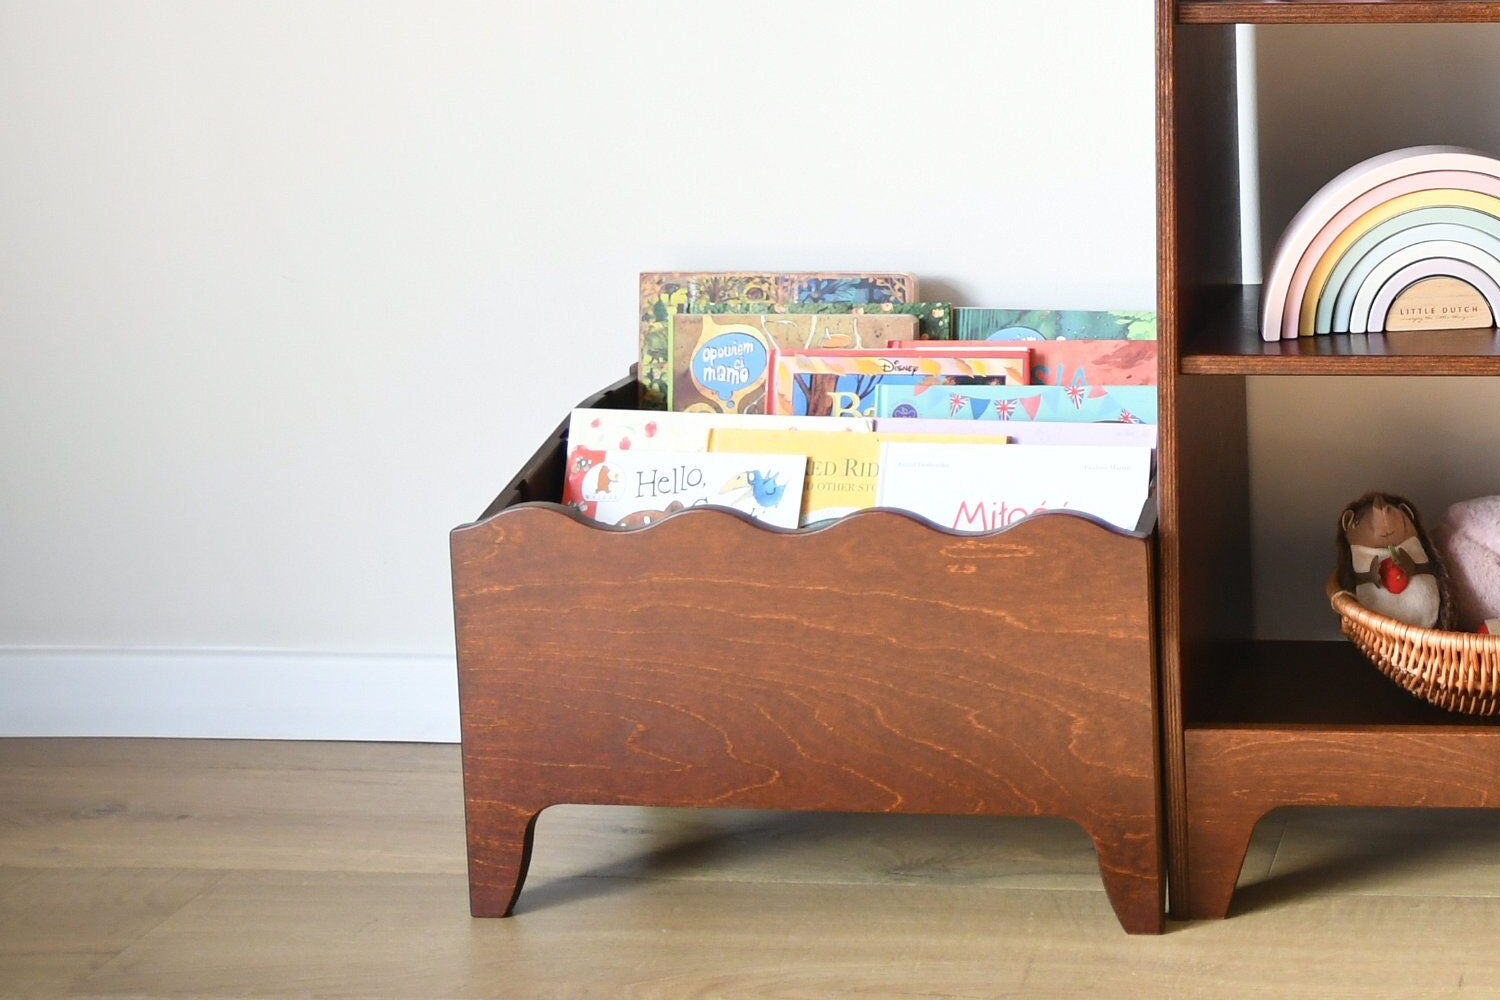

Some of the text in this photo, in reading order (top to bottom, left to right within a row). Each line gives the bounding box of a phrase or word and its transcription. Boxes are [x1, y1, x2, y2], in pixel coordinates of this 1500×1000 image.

[1400, 305, 1478, 315] LITTLE DUTCH
[702, 340, 754, 367] opowiem
[734, 355, 745, 370] ci
[703, 364, 749, 385] mamo
[635, 465, 706, 498] Hello,
[817, 482, 855, 492] OTHER
